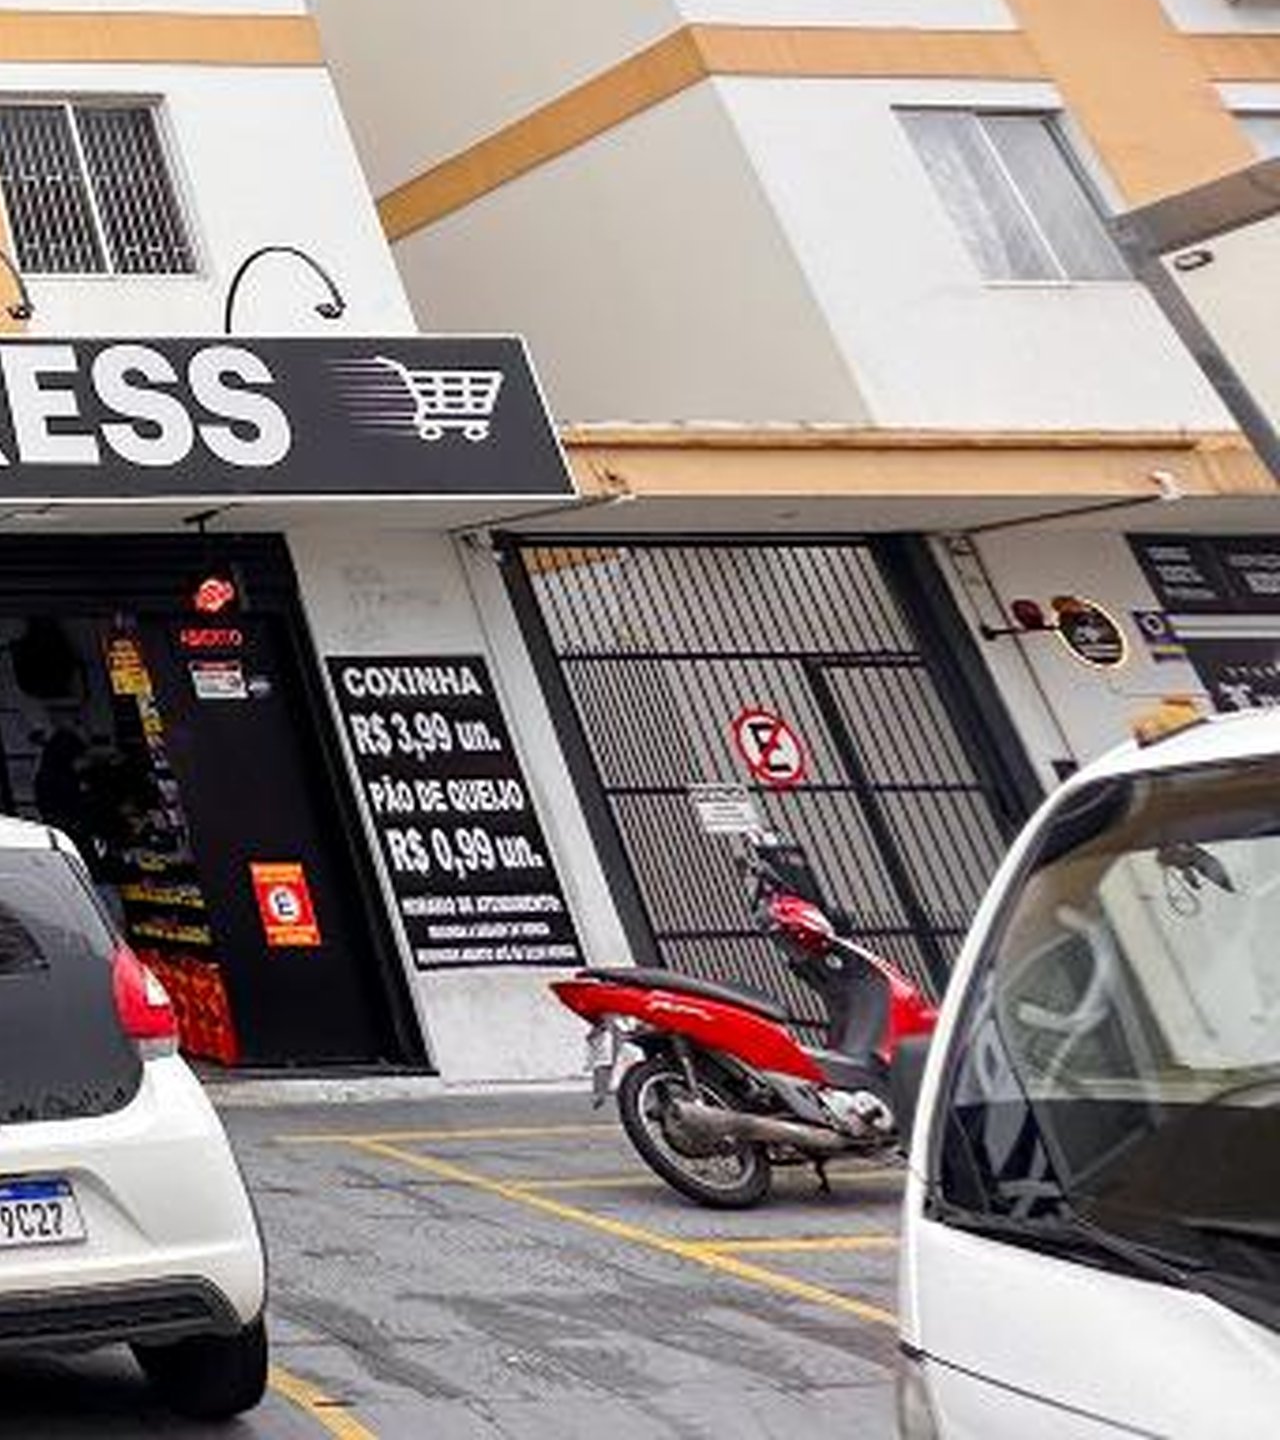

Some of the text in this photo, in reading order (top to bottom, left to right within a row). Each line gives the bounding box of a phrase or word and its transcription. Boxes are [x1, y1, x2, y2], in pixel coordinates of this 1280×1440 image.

[343, 667, 483, 698] COXINHA
[349, 712, 502, 761] R$ 3,99 un.
[368, 775, 525, 813] PÃO DE QUEIJO
[385, 827, 430, 876] R$
[431, 827, 495, 879] 0,99
